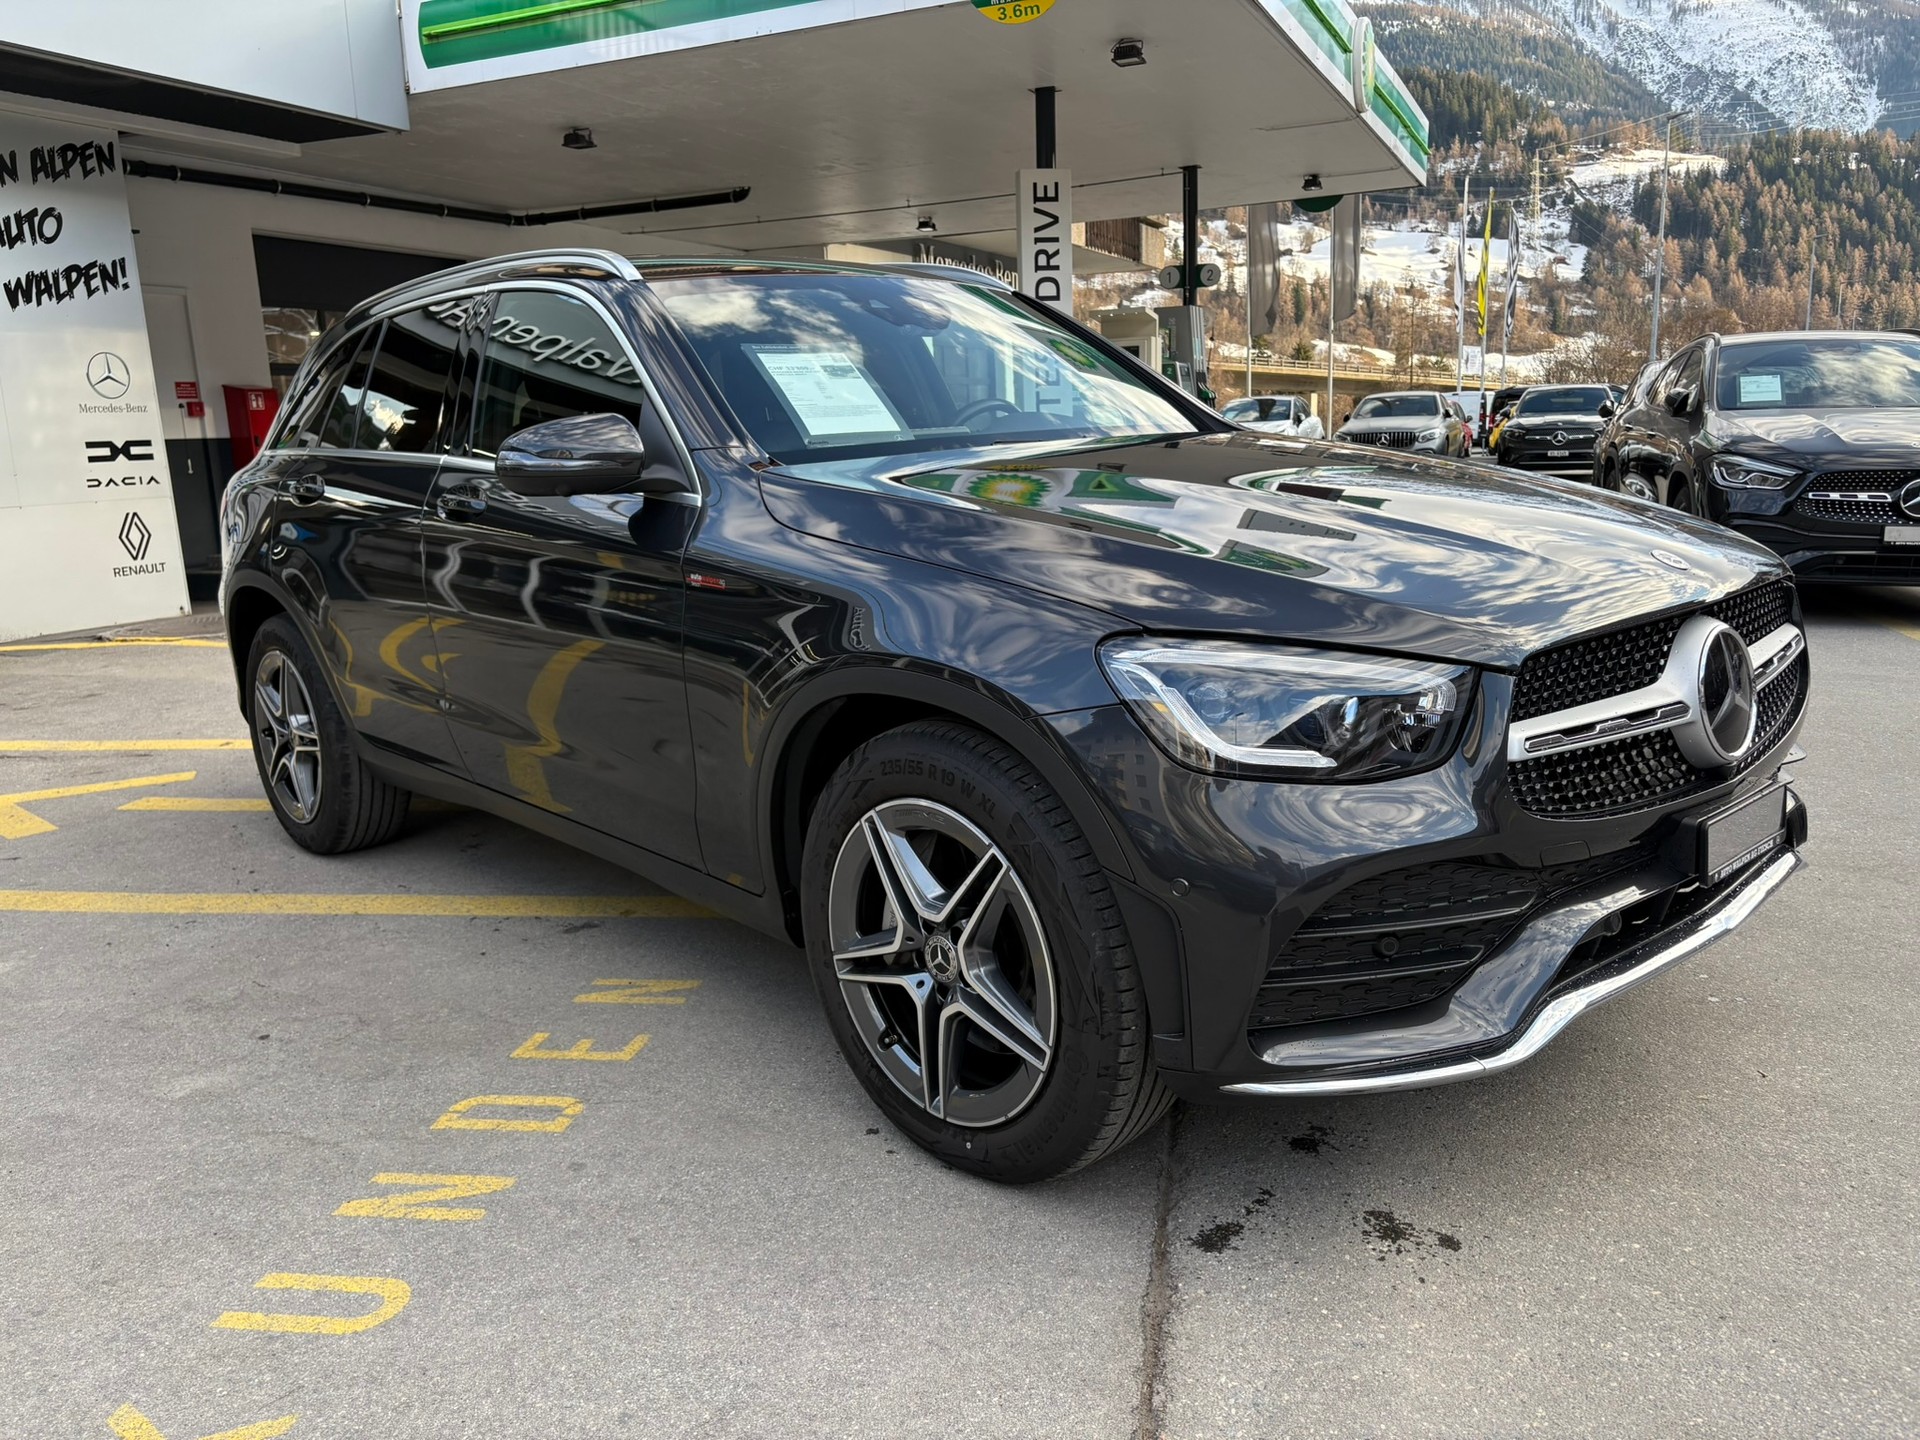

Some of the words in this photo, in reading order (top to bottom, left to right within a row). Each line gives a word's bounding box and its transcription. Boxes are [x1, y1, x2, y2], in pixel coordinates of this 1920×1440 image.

[997, 3, 1041, 21] 3.6m
[30, 141, 116, 185] ALPEN
[0, 207, 63, 250] UTO
[1033, 181, 1061, 302] DRIVE
[1167, 272, 1172, 284] 1
[1207, 269, 1214, 281] 2
[3, 257, 130, 312] WALPEN!
[79, 403, 148, 414] Mercedes-Benz
[86, 475, 160, 488] DACIA
[113, 562, 166, 577] RENAULT
[880, 759, 923, 777] 235/55
[928, 763, 937, 780] R
[941, 768, 955, 787] 19
[961, 779, 976, 799] W
[979, 792, 996, 820] XL
